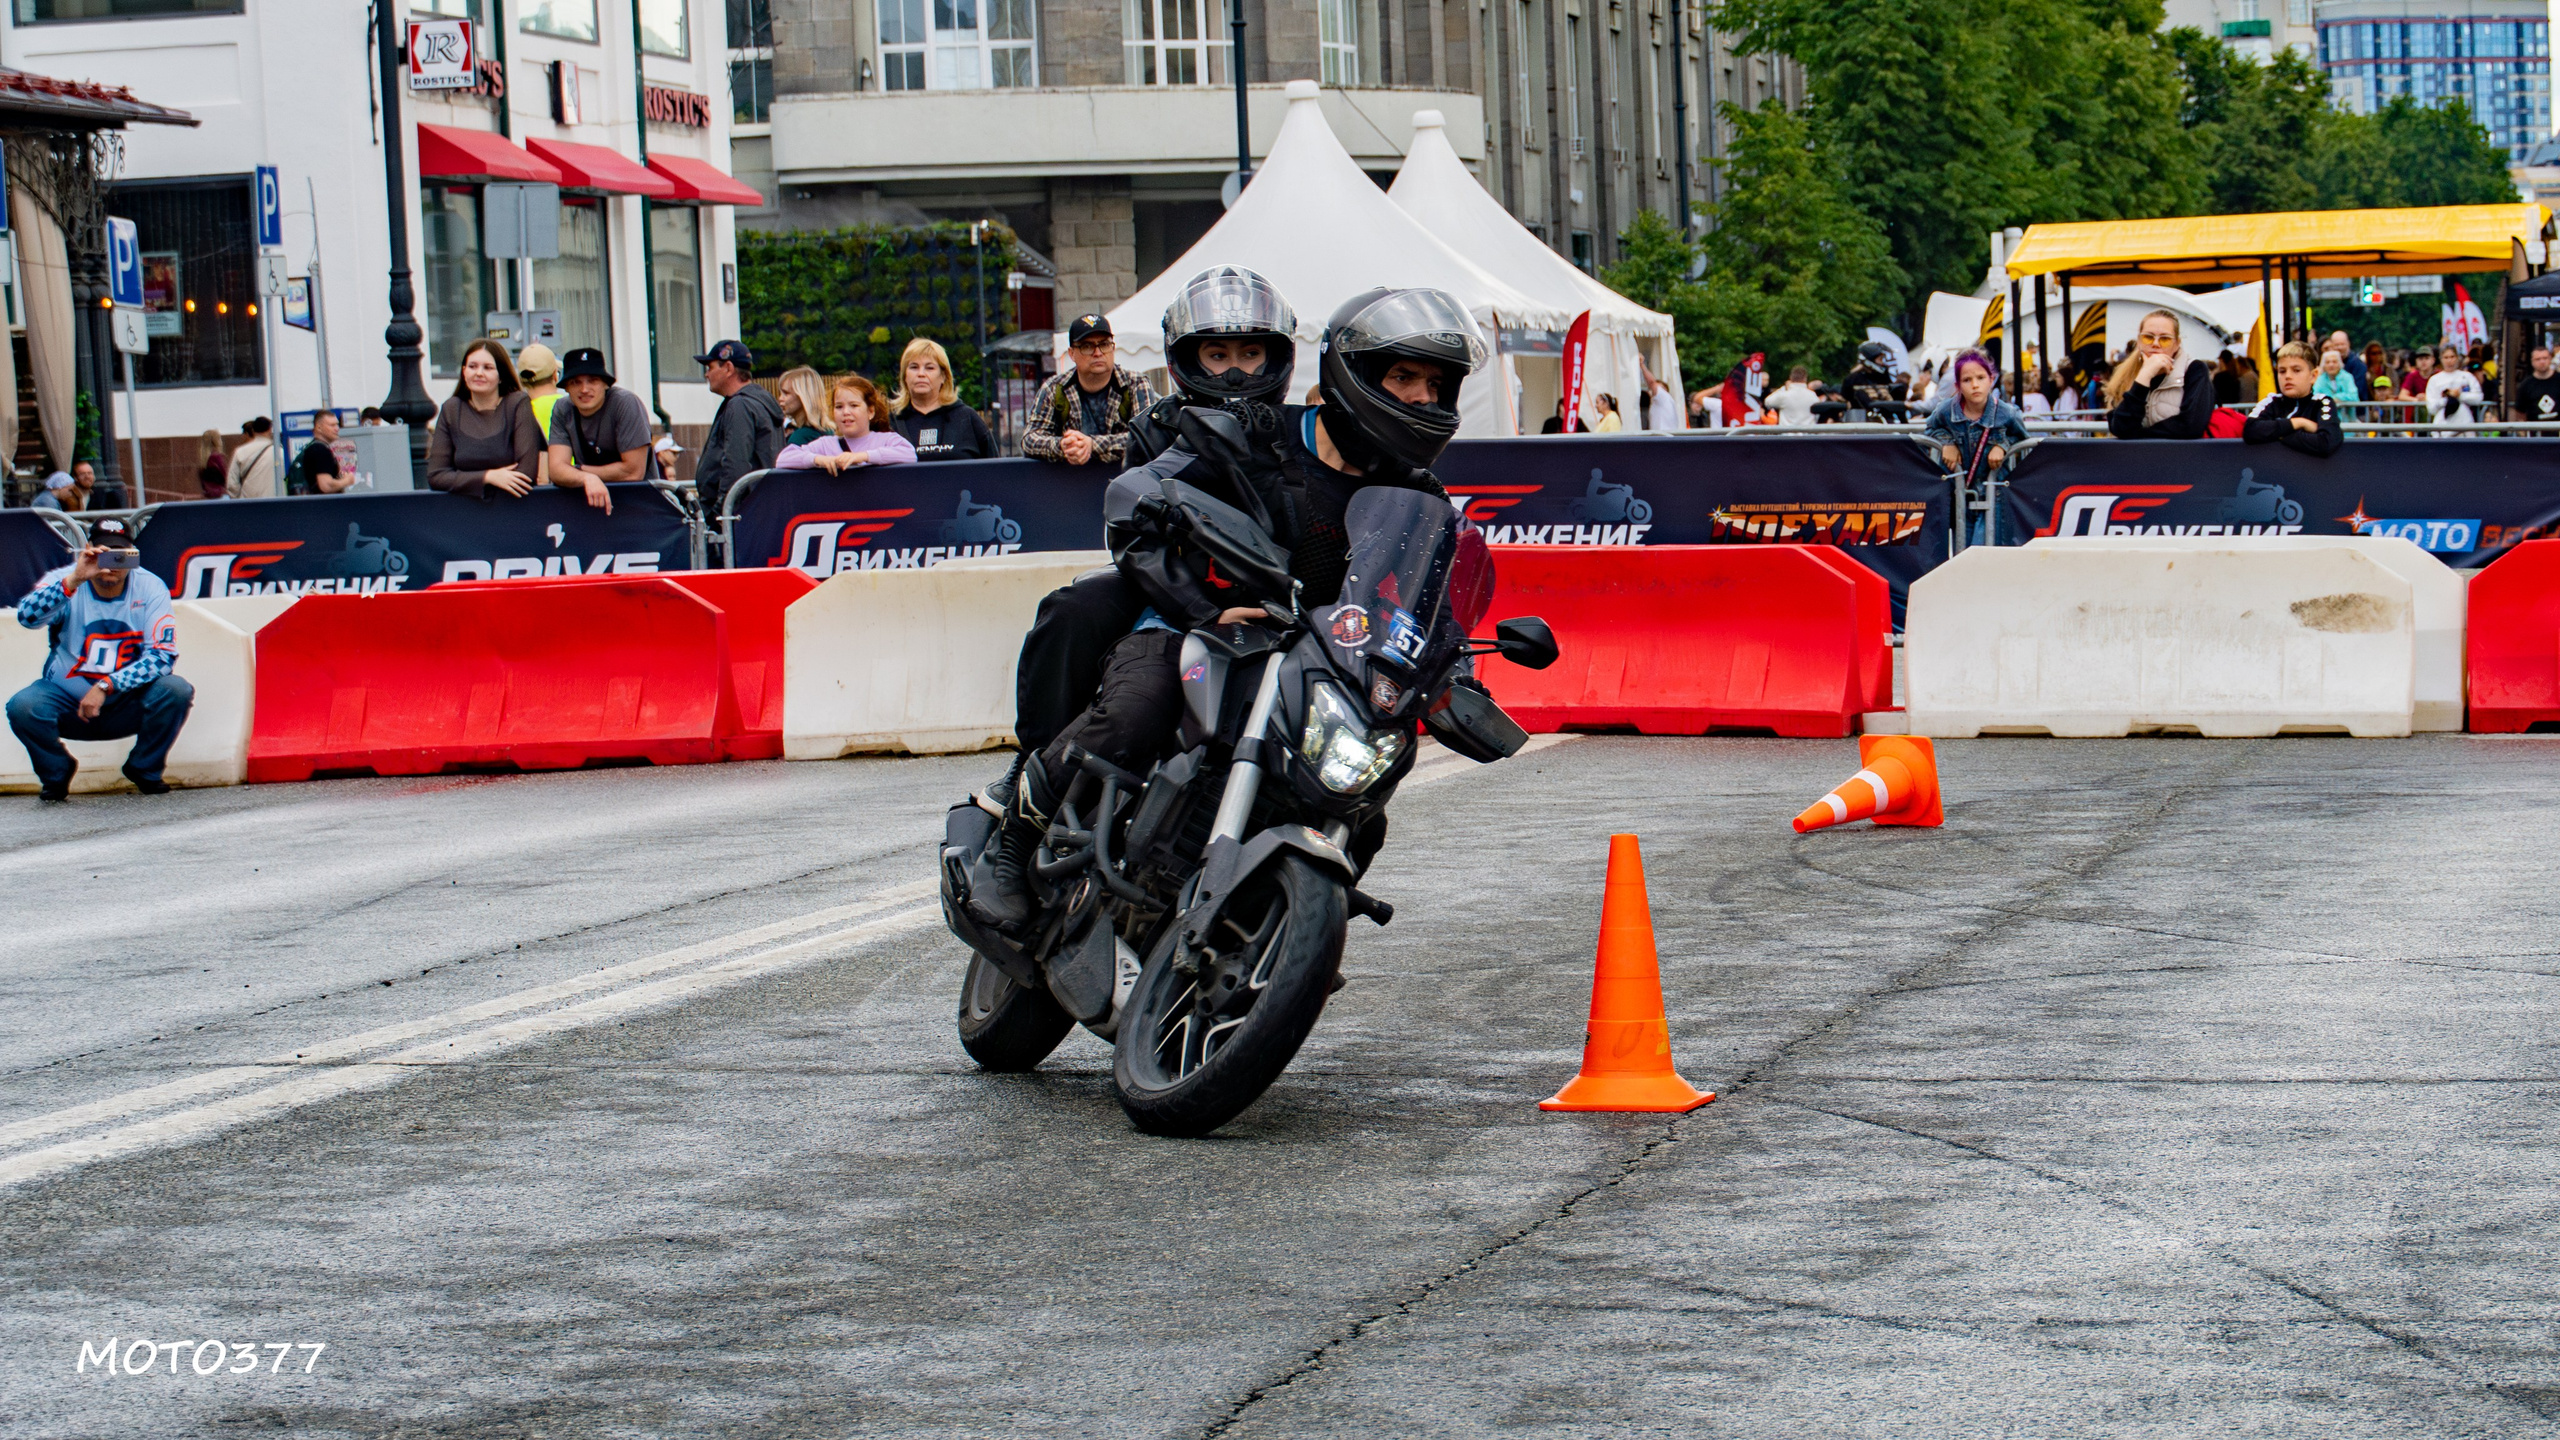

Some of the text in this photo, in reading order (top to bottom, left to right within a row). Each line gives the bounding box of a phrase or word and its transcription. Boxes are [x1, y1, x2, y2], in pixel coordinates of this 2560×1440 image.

[423, 33, 460, 64] R
[413, 76, 471, 86] ROSTIC'S
[644, 86, 712, 127] ROSTIC'S
[1396, 626, 1426, 659] 57
